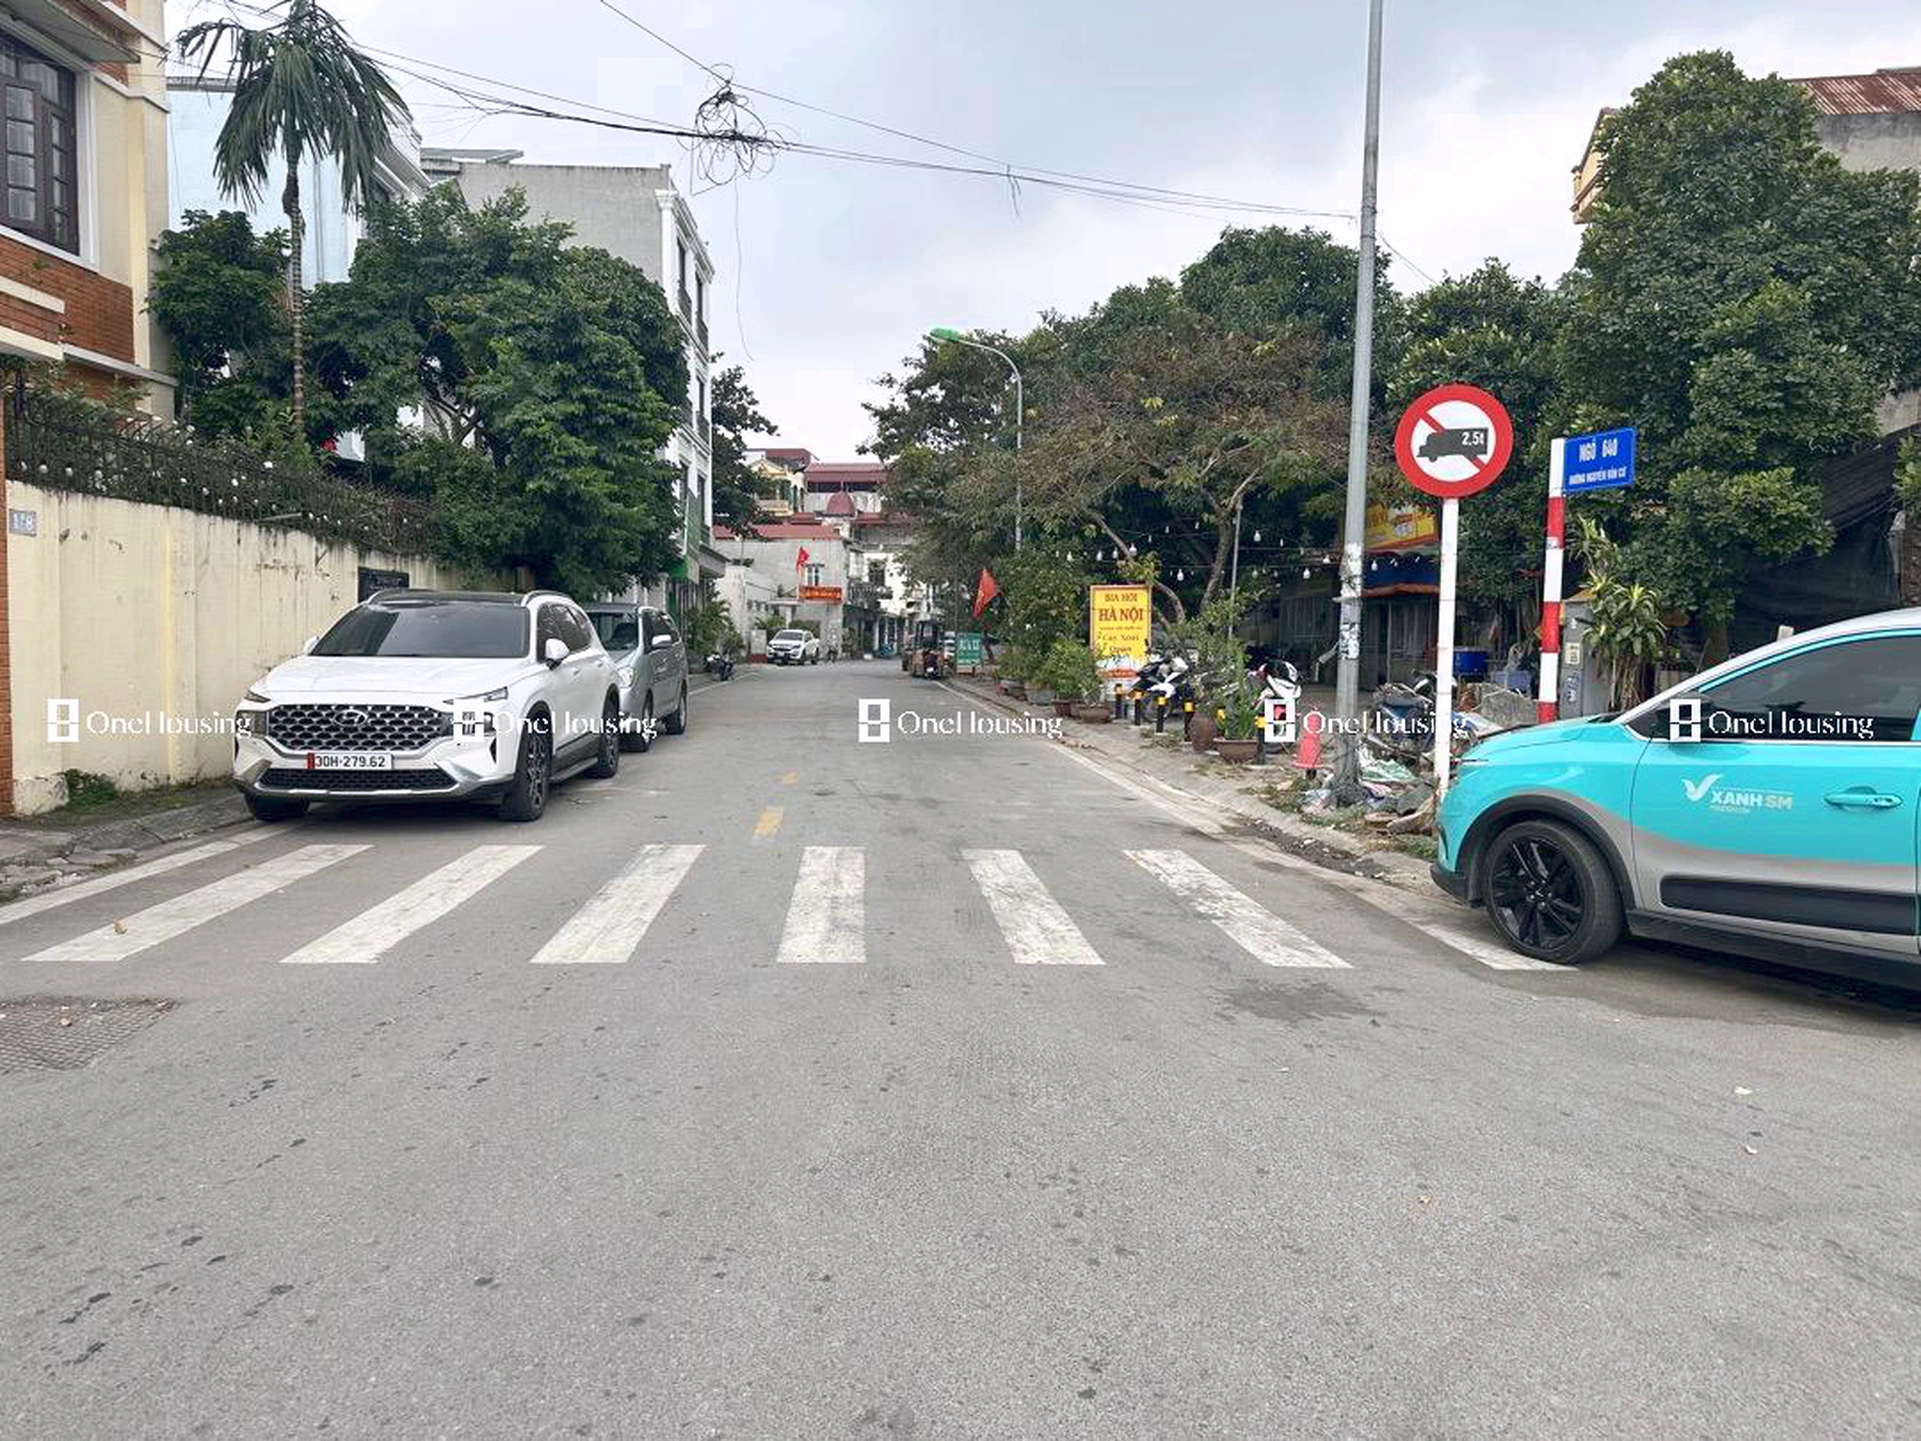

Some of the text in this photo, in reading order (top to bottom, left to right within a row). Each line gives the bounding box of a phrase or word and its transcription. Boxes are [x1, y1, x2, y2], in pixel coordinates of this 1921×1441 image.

[1098, 605, 1144, 624] HÀ NỘI
[1711, 789, 1763, 807] XANH
[1764, 795, 1793, 810] SM
